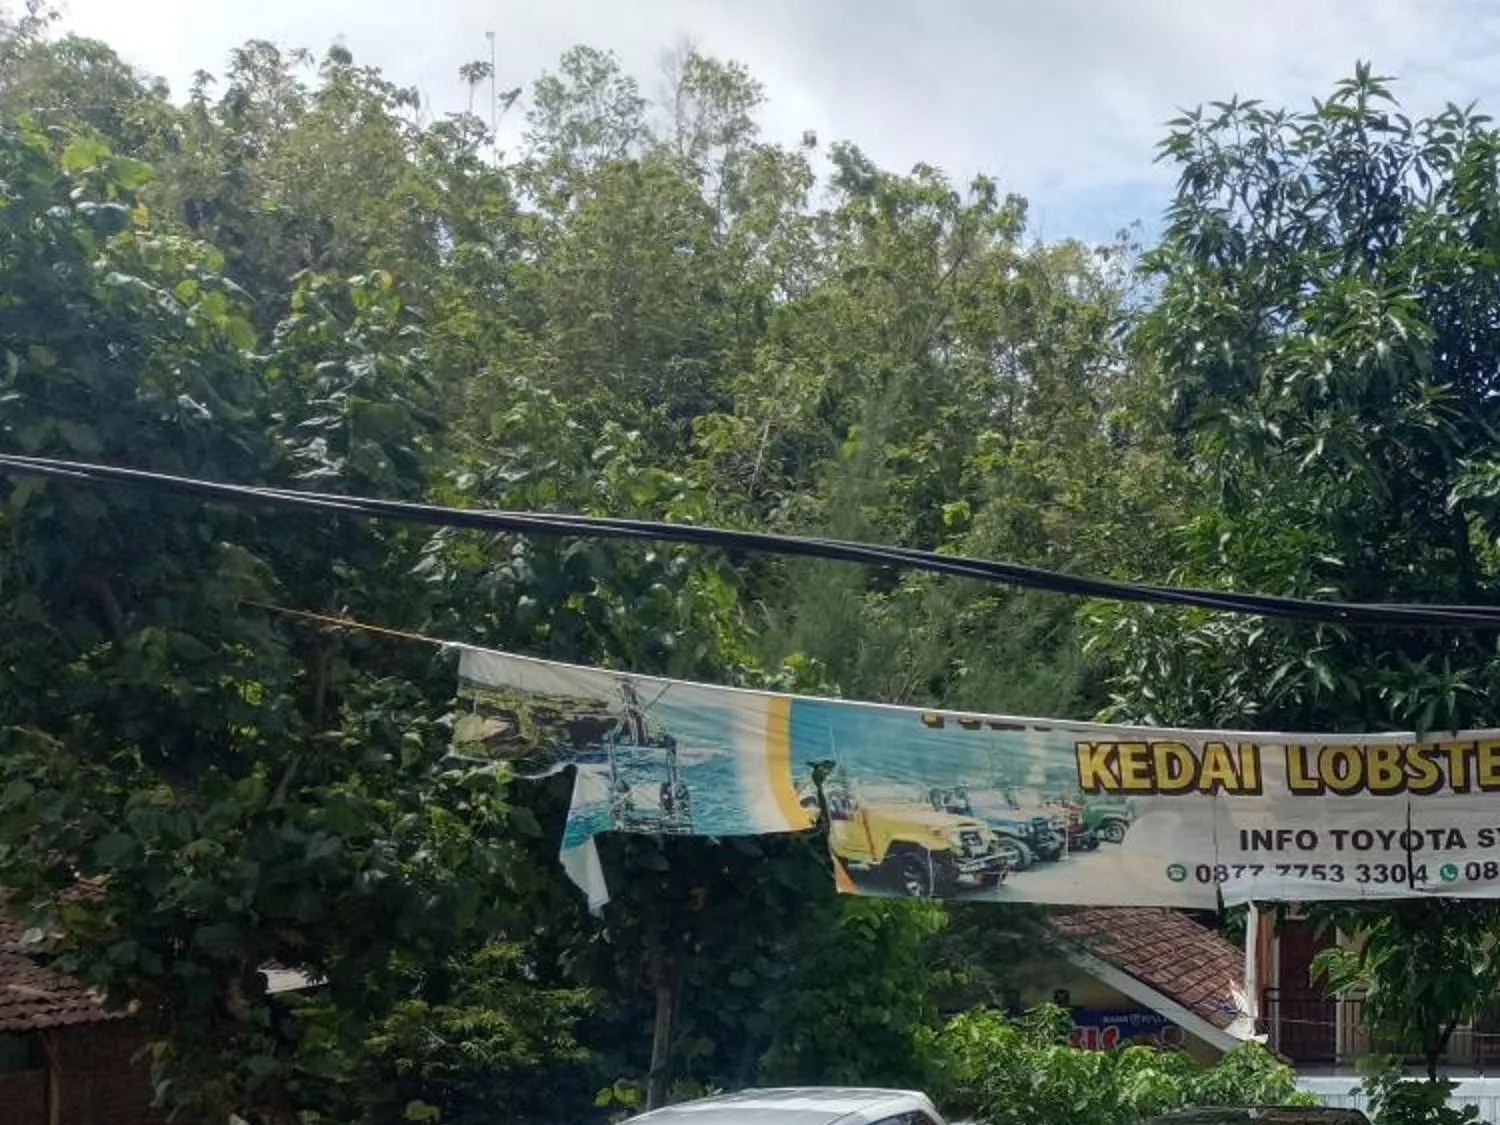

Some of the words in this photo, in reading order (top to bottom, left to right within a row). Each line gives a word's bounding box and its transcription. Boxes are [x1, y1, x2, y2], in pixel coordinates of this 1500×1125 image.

[1076, 741, 1262, 796] KEDAI
[1240, 829, 1318, 851] INFO
[1330, 829, 1467, 851] TOYOTA
[1195, 863, 1264, 884] 0877
[1275, 863, 1345, 883] 7753
[1356, 863, 1429, 885] 3304
